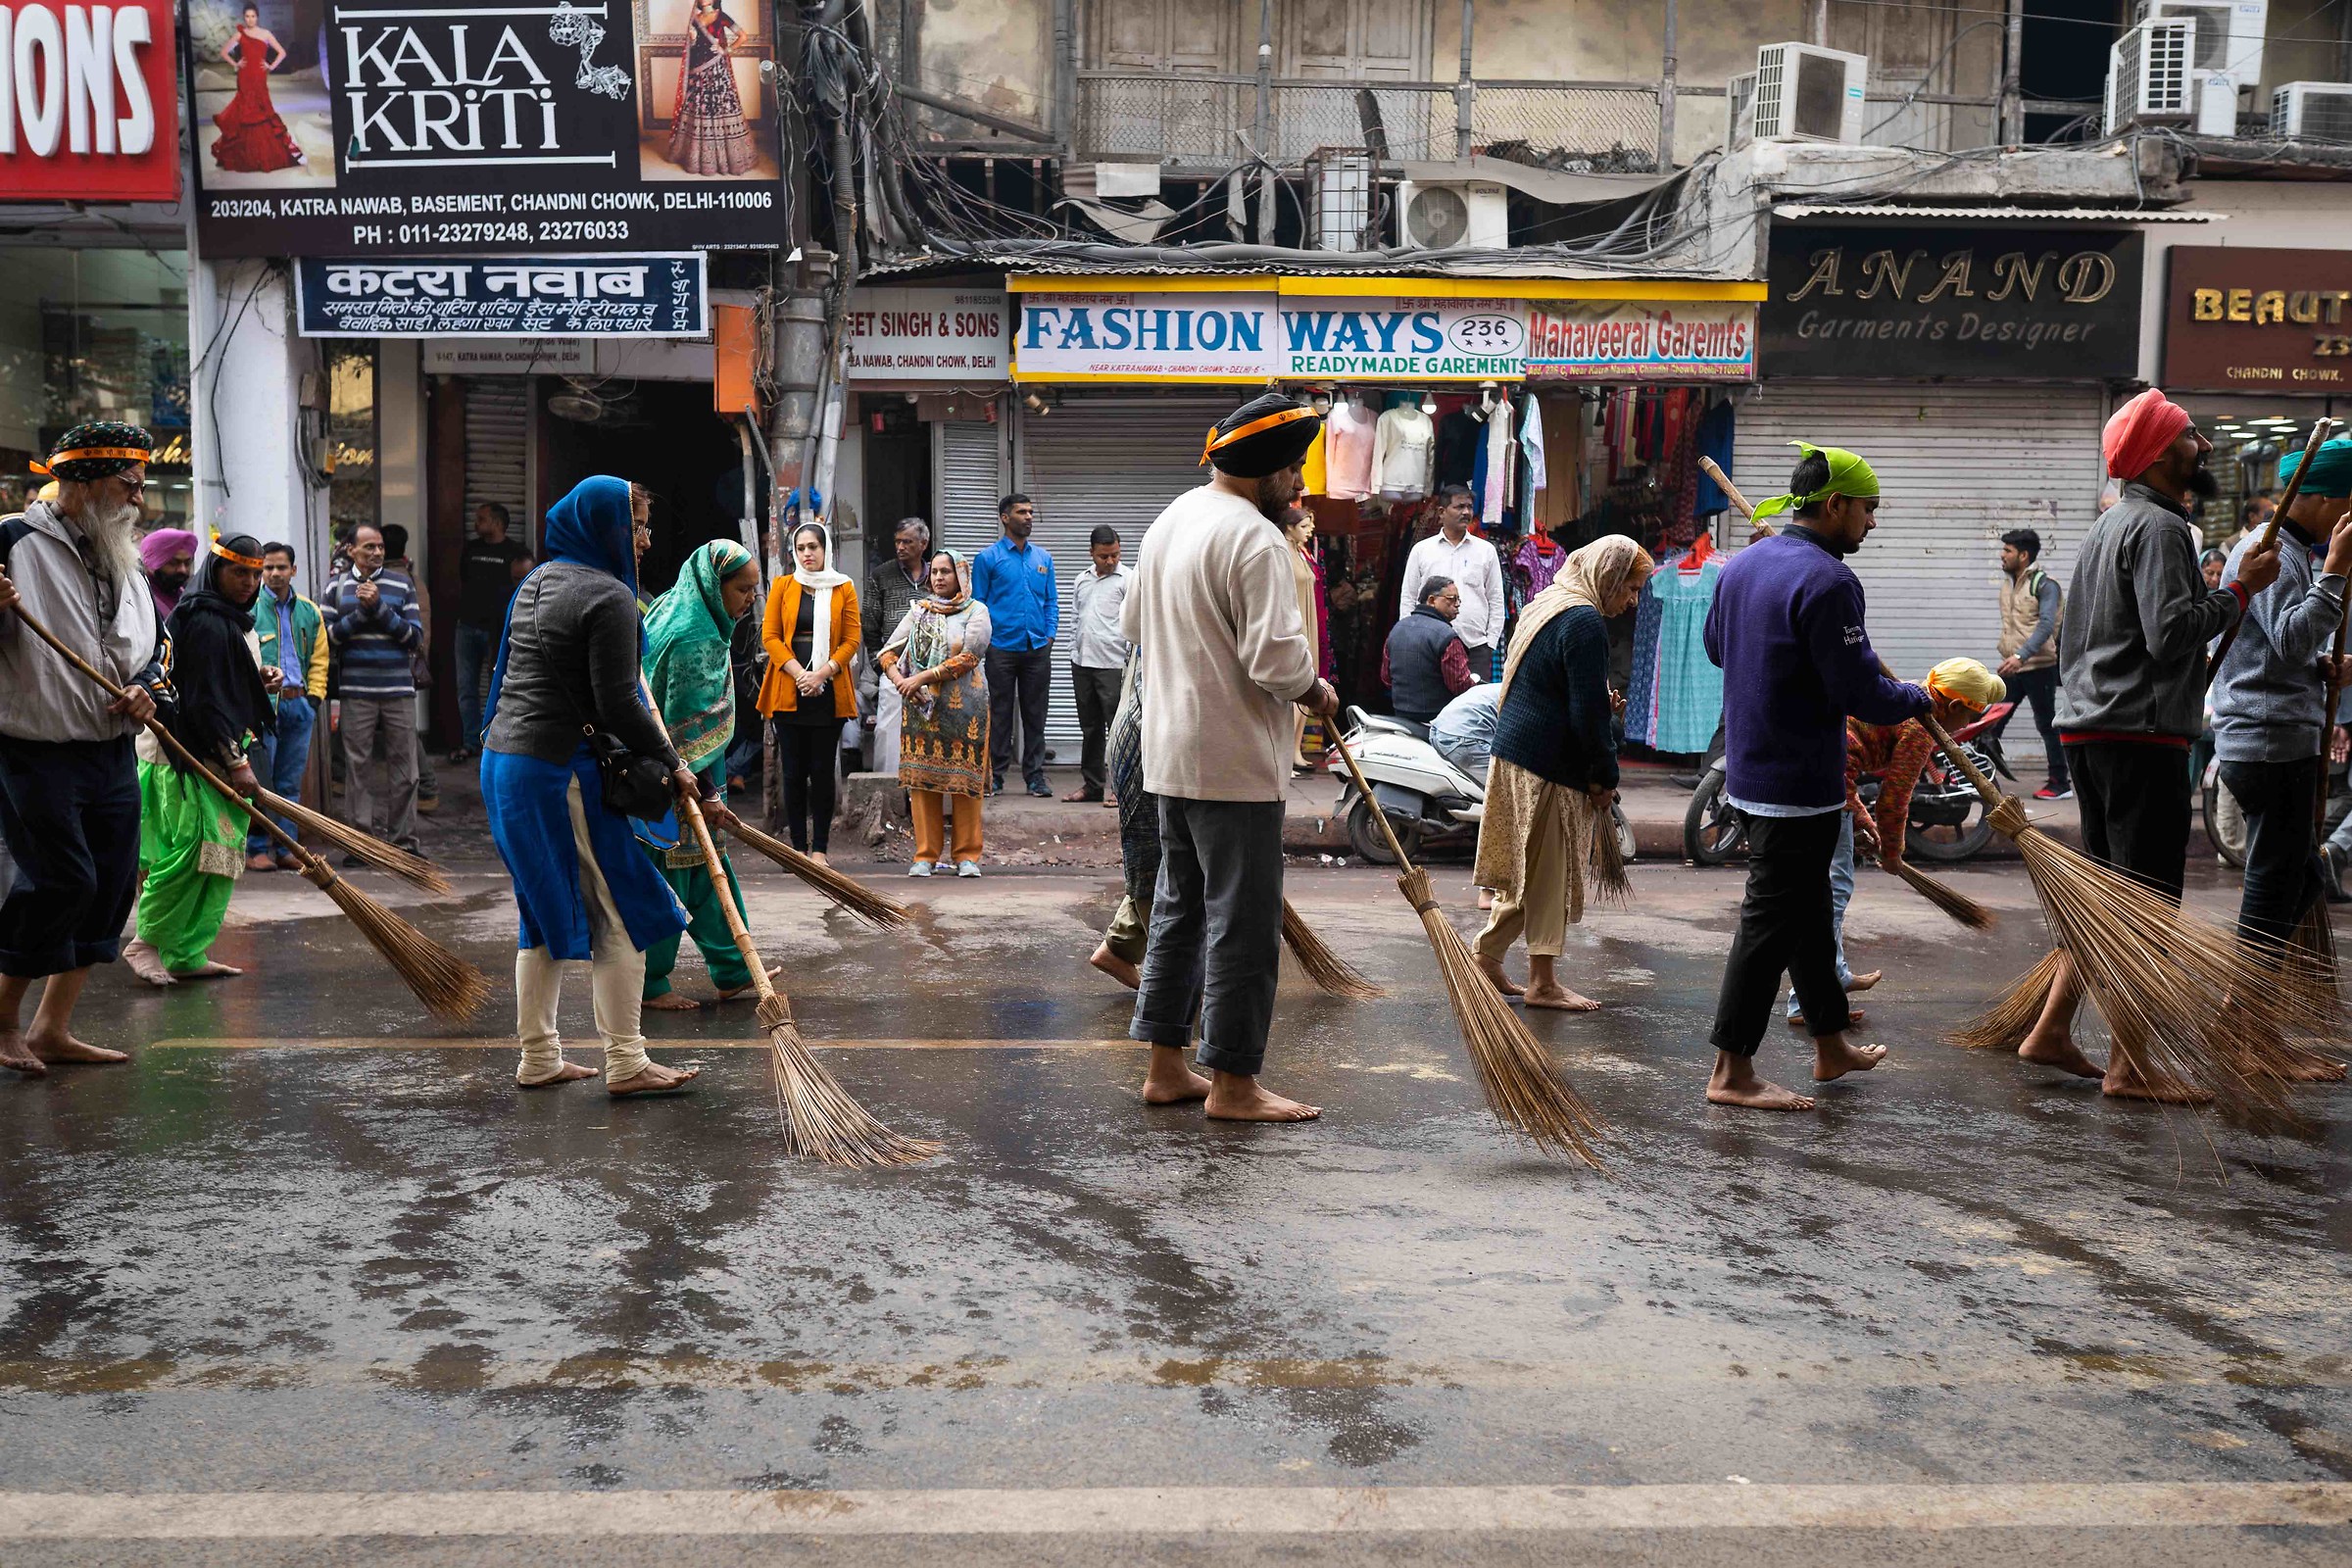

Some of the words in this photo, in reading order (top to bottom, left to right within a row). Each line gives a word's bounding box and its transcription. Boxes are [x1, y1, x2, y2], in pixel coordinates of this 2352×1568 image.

[341, 24, 551, 87] KALA
[211, 199, 276, 220] 203/204,
[280, 198, 337, 217] KATRA
[341, 197, 407, 217] NAWAB,
[411, 195, 508, 214] BASEMENT,
[511, 194, 587, 211] CHANDNI
[591, 192, 660, 213] CHOWK,
[663, 192, 772, 210] DELHI-110006
[353, 225, 381, 244] PH
[399, 221, 534, 244] 011-23279248,
[539, 220, 629, 240] 23276033
[325, 265, 472, 297] कटरा
[482, 266, 650, 298] नवाब
[1787, 246, 2116, 303] ANAND
[411, 296, 434, 315] की
[642, 304, 659, 317] व
[565, 316, 583, 330] के
[585, 316, 615, 331] लिए
[881, 312, 932, 337] SINGH
[938, 312, 950, 337] &
[955, 312, 1000, 338] SONS
[1023, 307, 1264, 352] FASHION
[1281, 311, 1444, 354] WAYS
[1461, 319, 1506, 336] 236
[1529, 310, 1651, 360] Mahaveerai
[1656, 309, 1746, 358] Garemts
[1797, 310, 1948, 341] Garments
[1956, 312, 2096, 350] Designer
[862, 355, 896, 370] NAWAB,
[897, 355, 934, 368] CHANDNI
[936, 355, 970, 370] CHOWK,
[971, 355, 997, 368] DELHI
[1292, 356, 1420, 373] READYMADE
[1425, 357, 1527, 374] GAREMENTS
[1569, 366, 1588, 375] Near
[2227, 367, 2282, 379] CHANDNI
